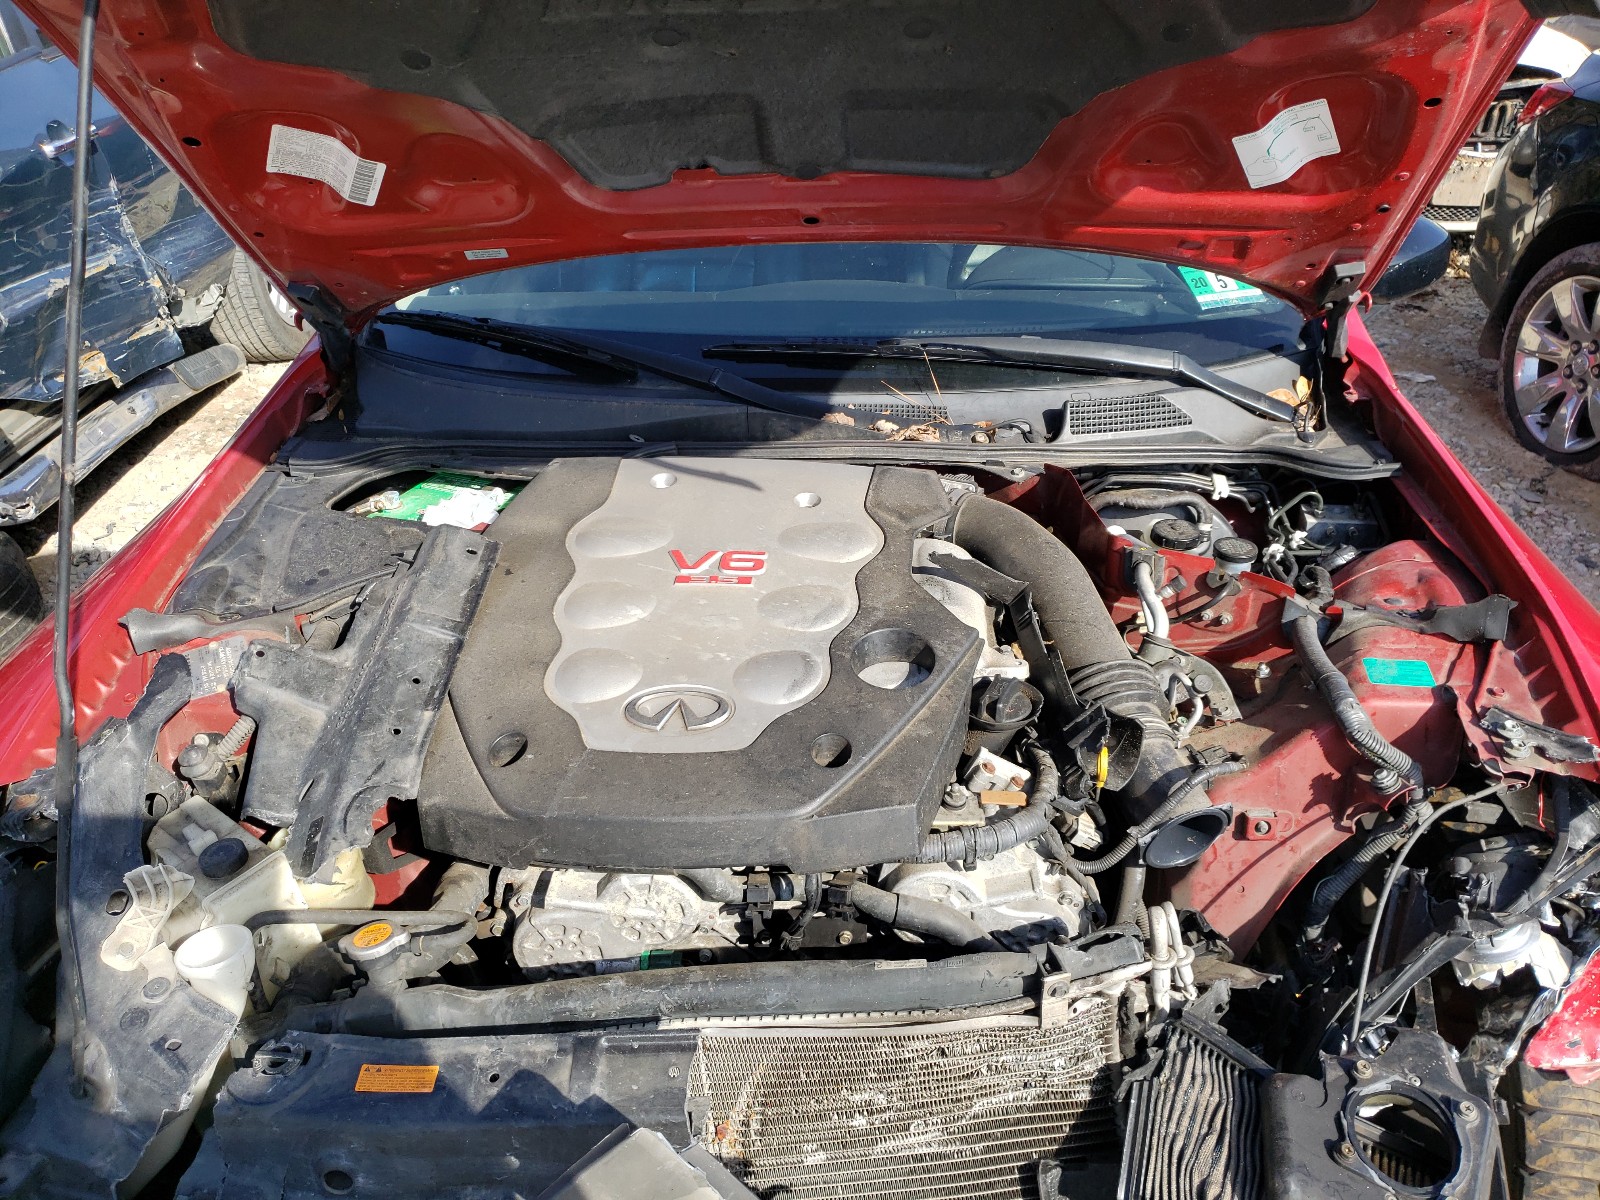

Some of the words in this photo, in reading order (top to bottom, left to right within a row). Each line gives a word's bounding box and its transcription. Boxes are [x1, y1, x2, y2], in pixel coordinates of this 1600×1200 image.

[1190, 277, 1208, 289] 20
[1215, 273, 1228, 289] 5
[668, 549, 768, 572] V6
